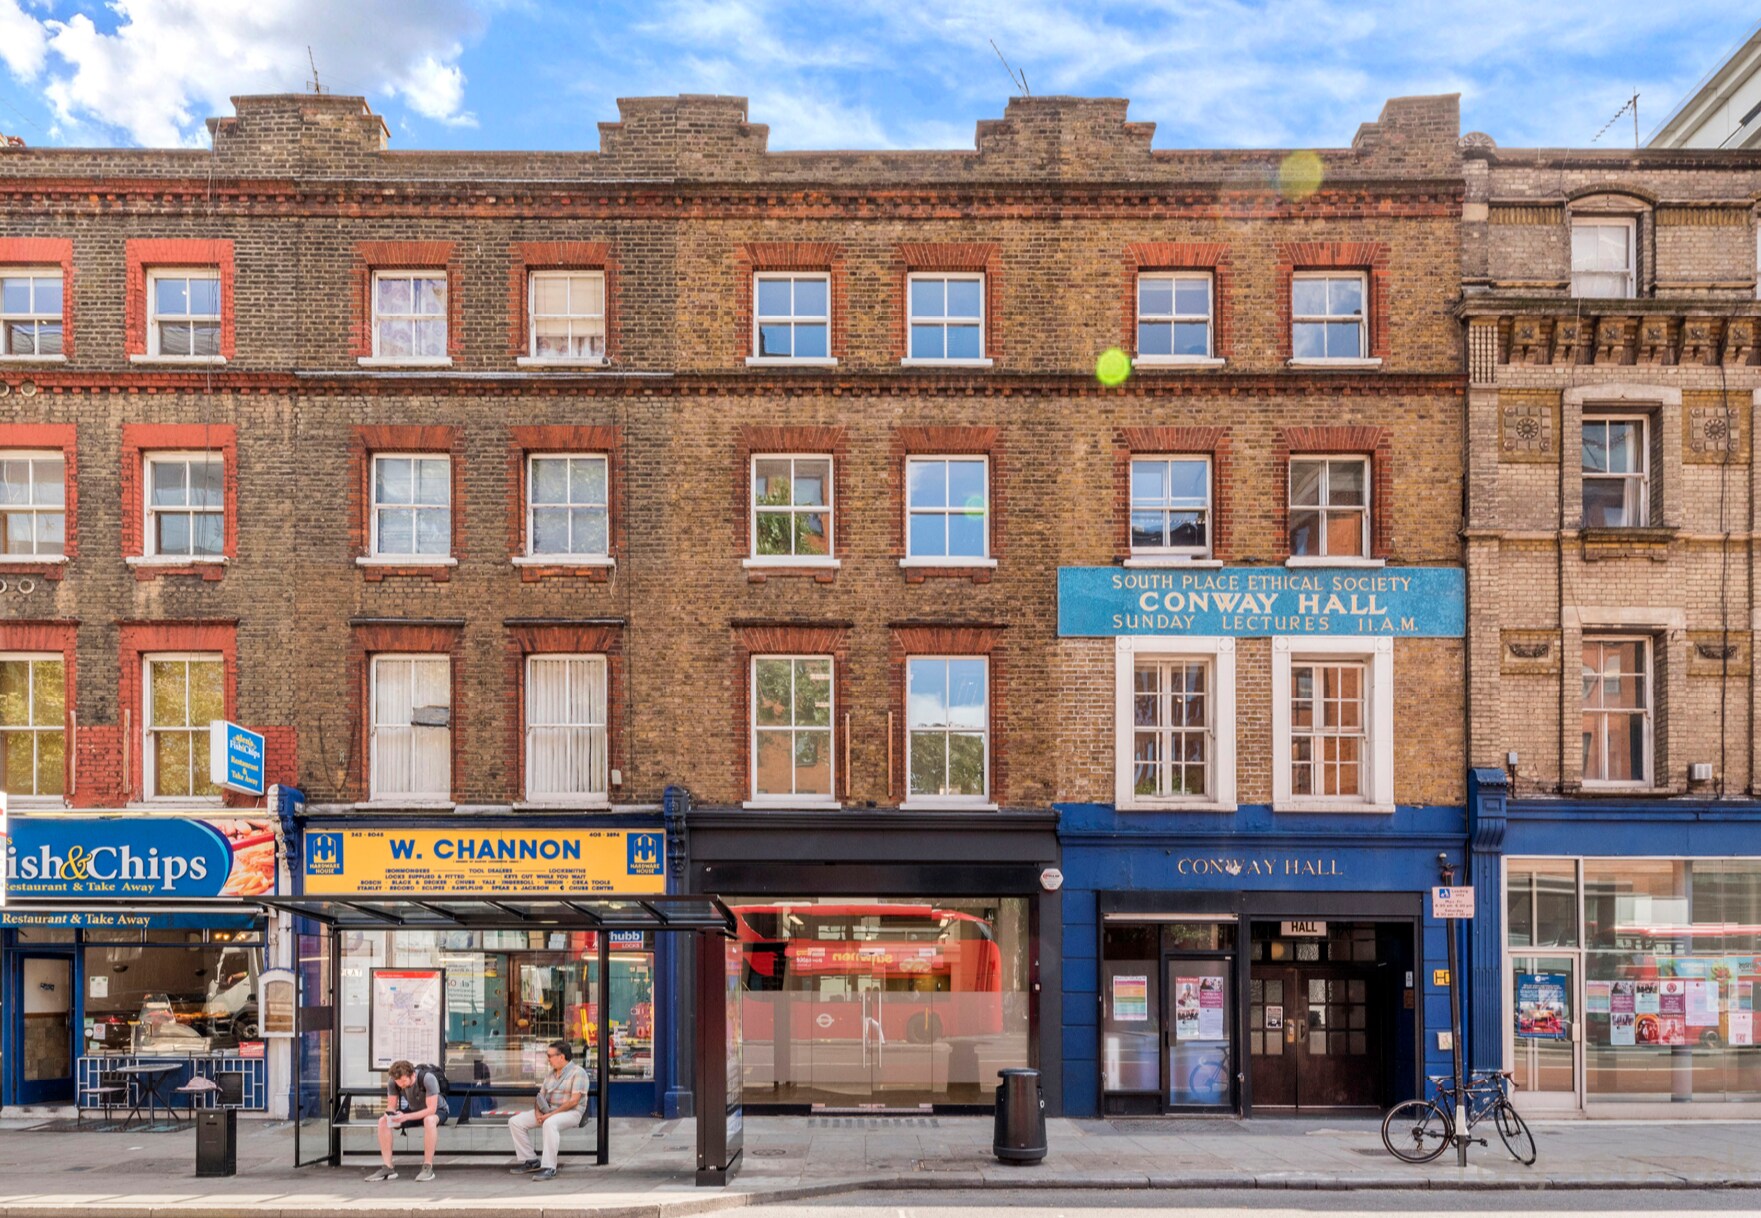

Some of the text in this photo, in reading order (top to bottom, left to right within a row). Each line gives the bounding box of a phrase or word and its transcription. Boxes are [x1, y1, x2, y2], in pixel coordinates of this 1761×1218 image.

[1112, 574, 1412, 592] SOUTH PLACE ETHICAL SOCIETY
[1139, 591, 1388, 616] CONWAY HALL
[1112, 614, 1196, 630] SUNDAY
[1221, 615, 1330, 631] LECTURES
[389, 839, 581, 860] W. CHANNON
[1177, 858, 1343, 876] CONWAY HALL
[72, 882, 83, 892] &
[86, 882, 116, 892] Take
[121, 882, 155, 894] Away
[2, 913, 151, 928] Restaurant & Take Away
[1291, 921, 1317, 932] HALL
[609, 930, 640, 941] hubb
